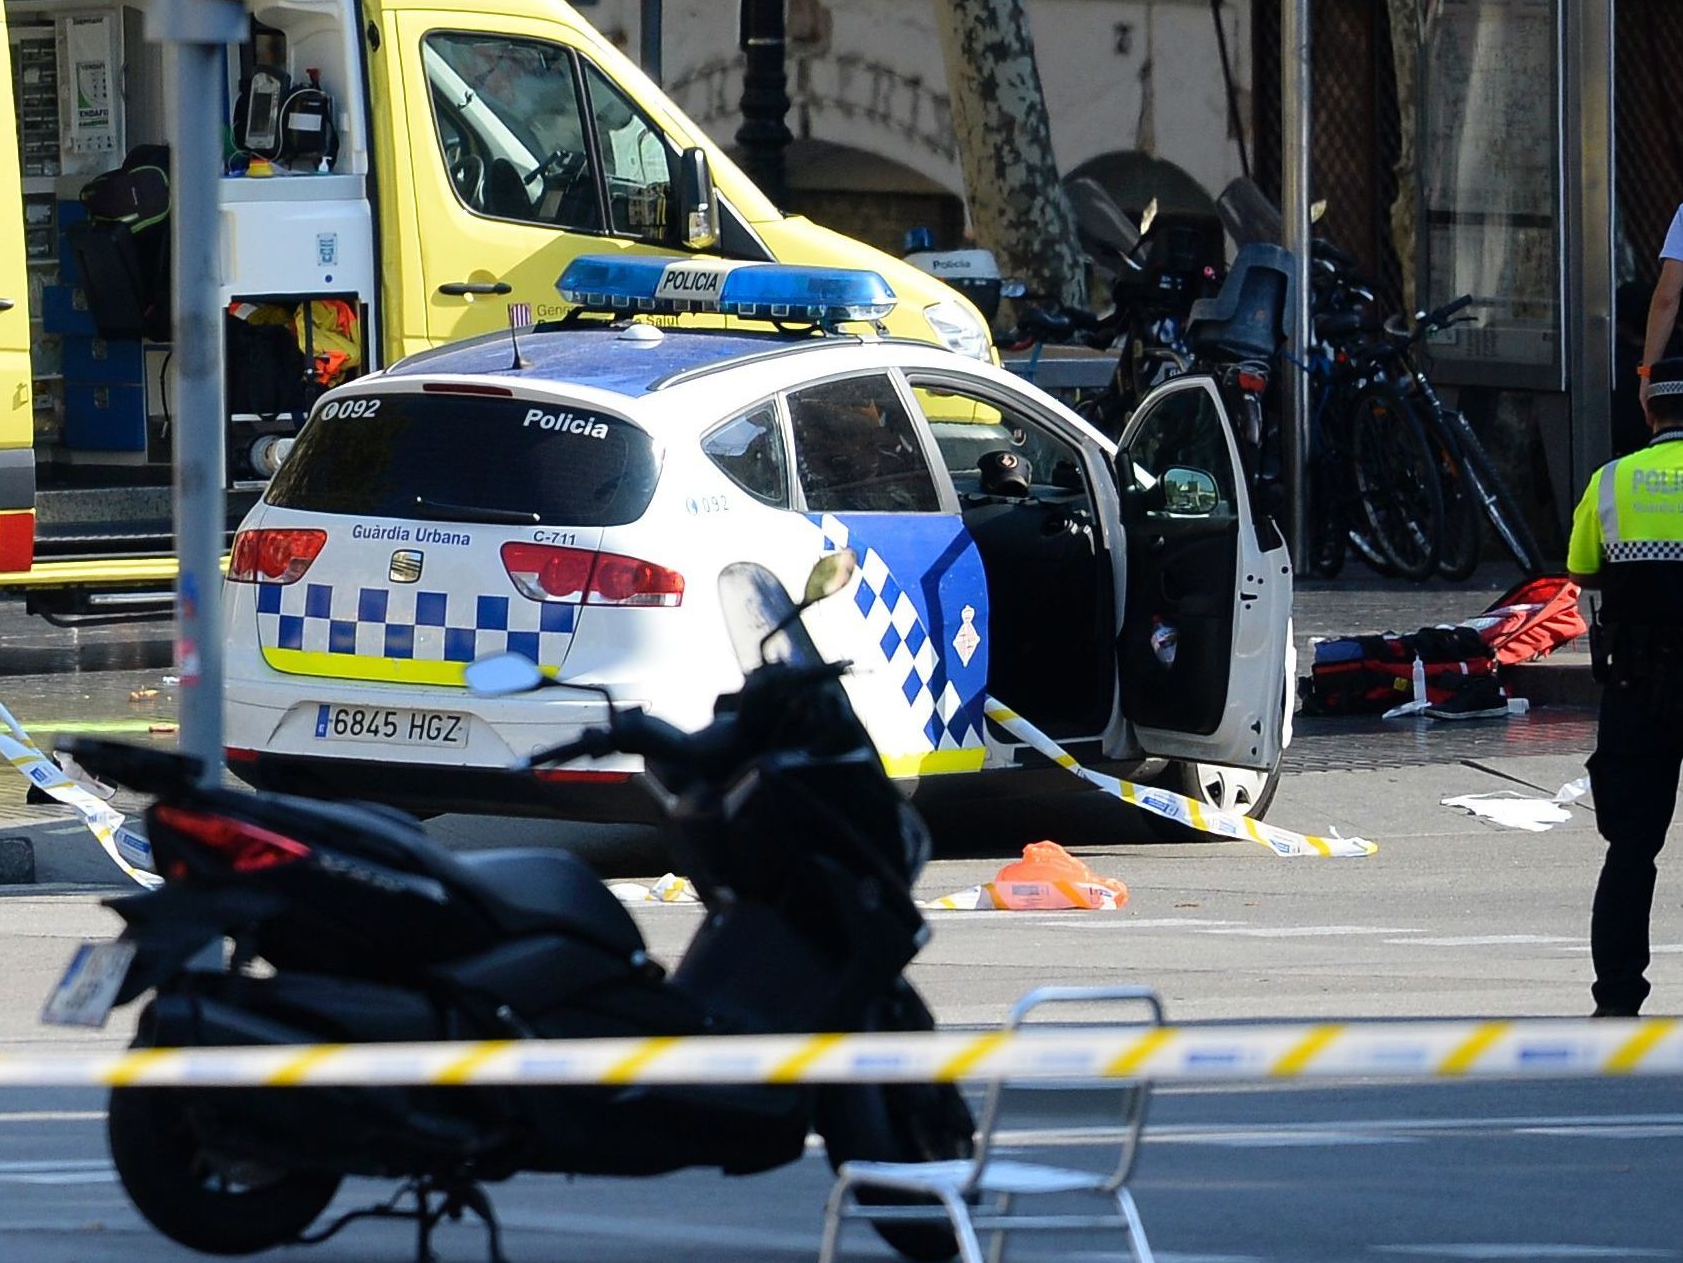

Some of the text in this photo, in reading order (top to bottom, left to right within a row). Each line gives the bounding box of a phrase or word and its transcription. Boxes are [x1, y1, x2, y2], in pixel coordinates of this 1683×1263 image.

[662, 271, 719, 291] POLICIA
[337, 399, 382, 419] 092
[523, 408, 610, 440] Policia
[352, 524, 471, 546] Guàrdia Urbana
[533, 530, 577, 546] C-711
[333, 708, 398, 738] 6845
[408, 713, 462, 742] HGZ
